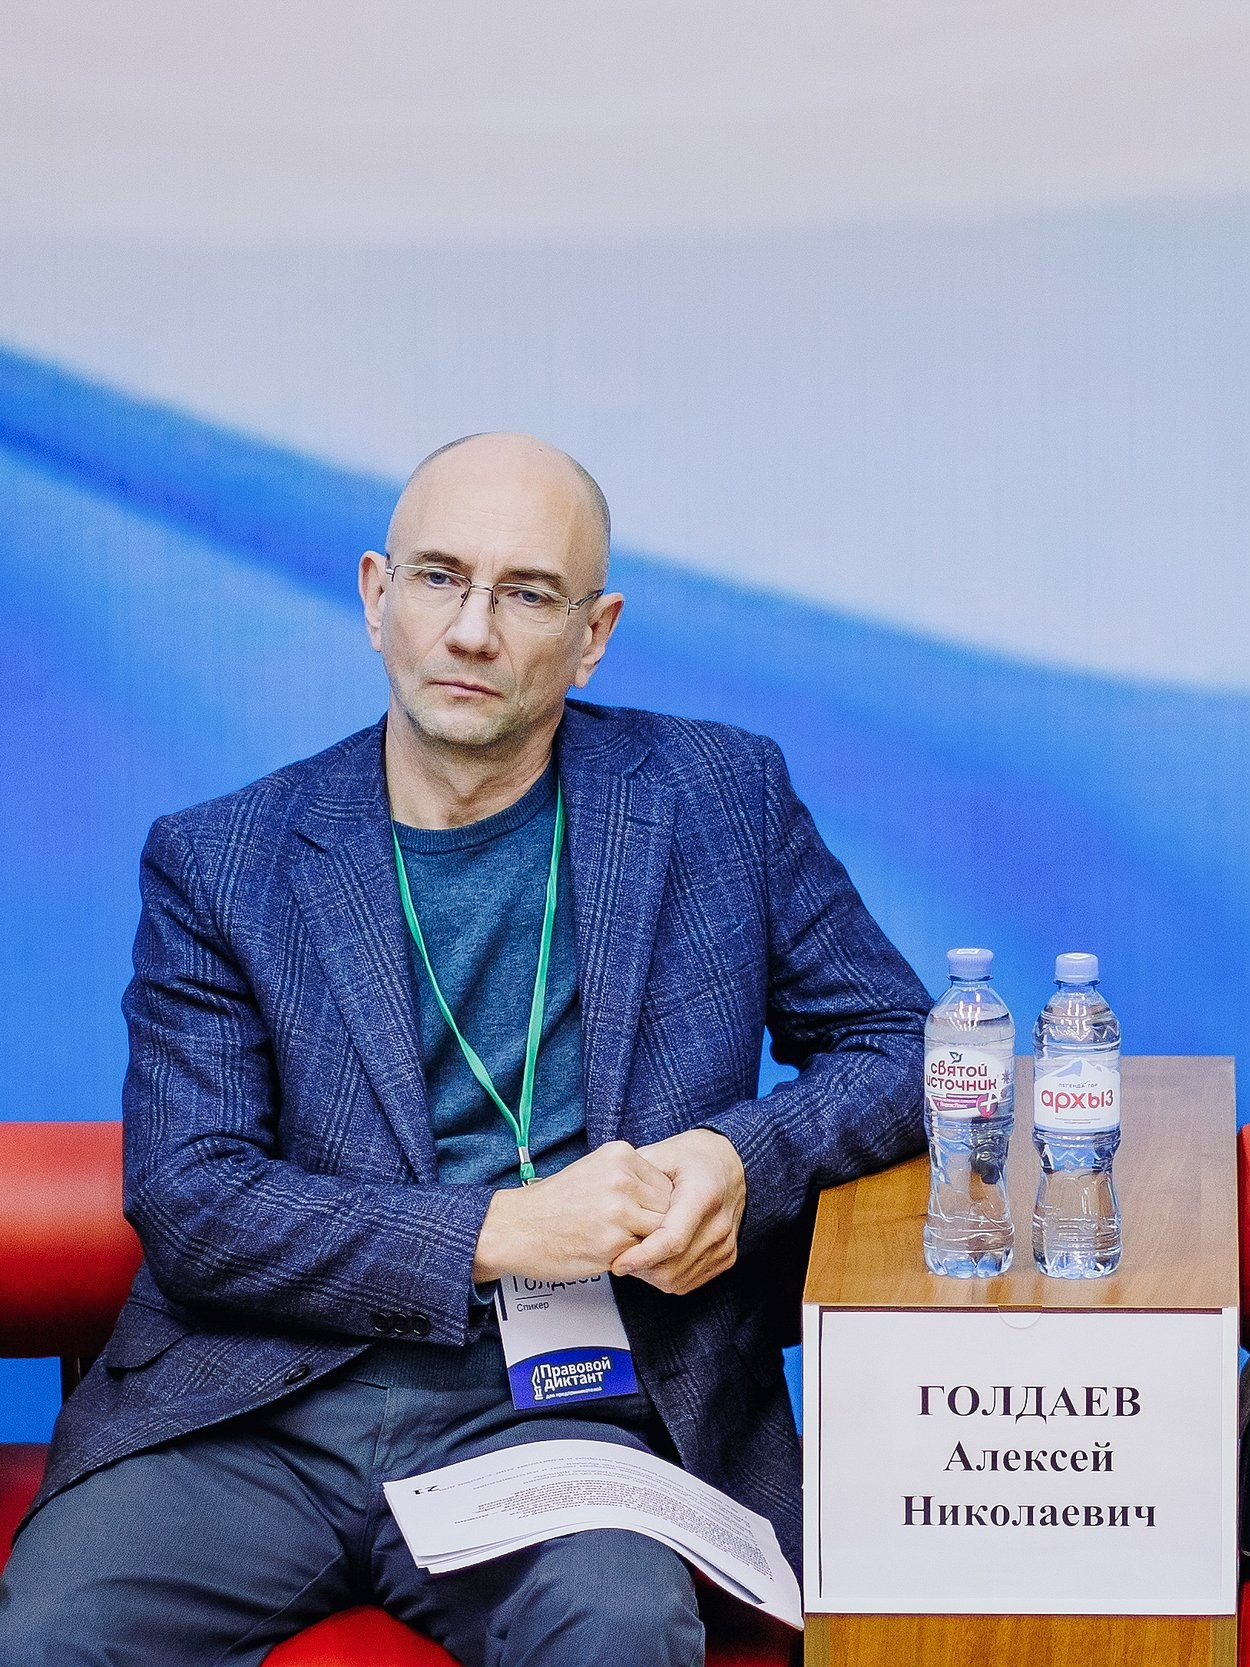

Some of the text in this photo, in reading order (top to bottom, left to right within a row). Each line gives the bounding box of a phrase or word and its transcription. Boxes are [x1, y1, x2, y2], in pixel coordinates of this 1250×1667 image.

[516, 1301, 550, 1312] Спикер
[540, 1356, 612, 1378] Правовой
[916, 1385, 1142, 1424] ГОЛДАЕВ
[943, 1441, 1114, 1472] Алексей
[901, 1495, 1157, 1527] Николаевич
